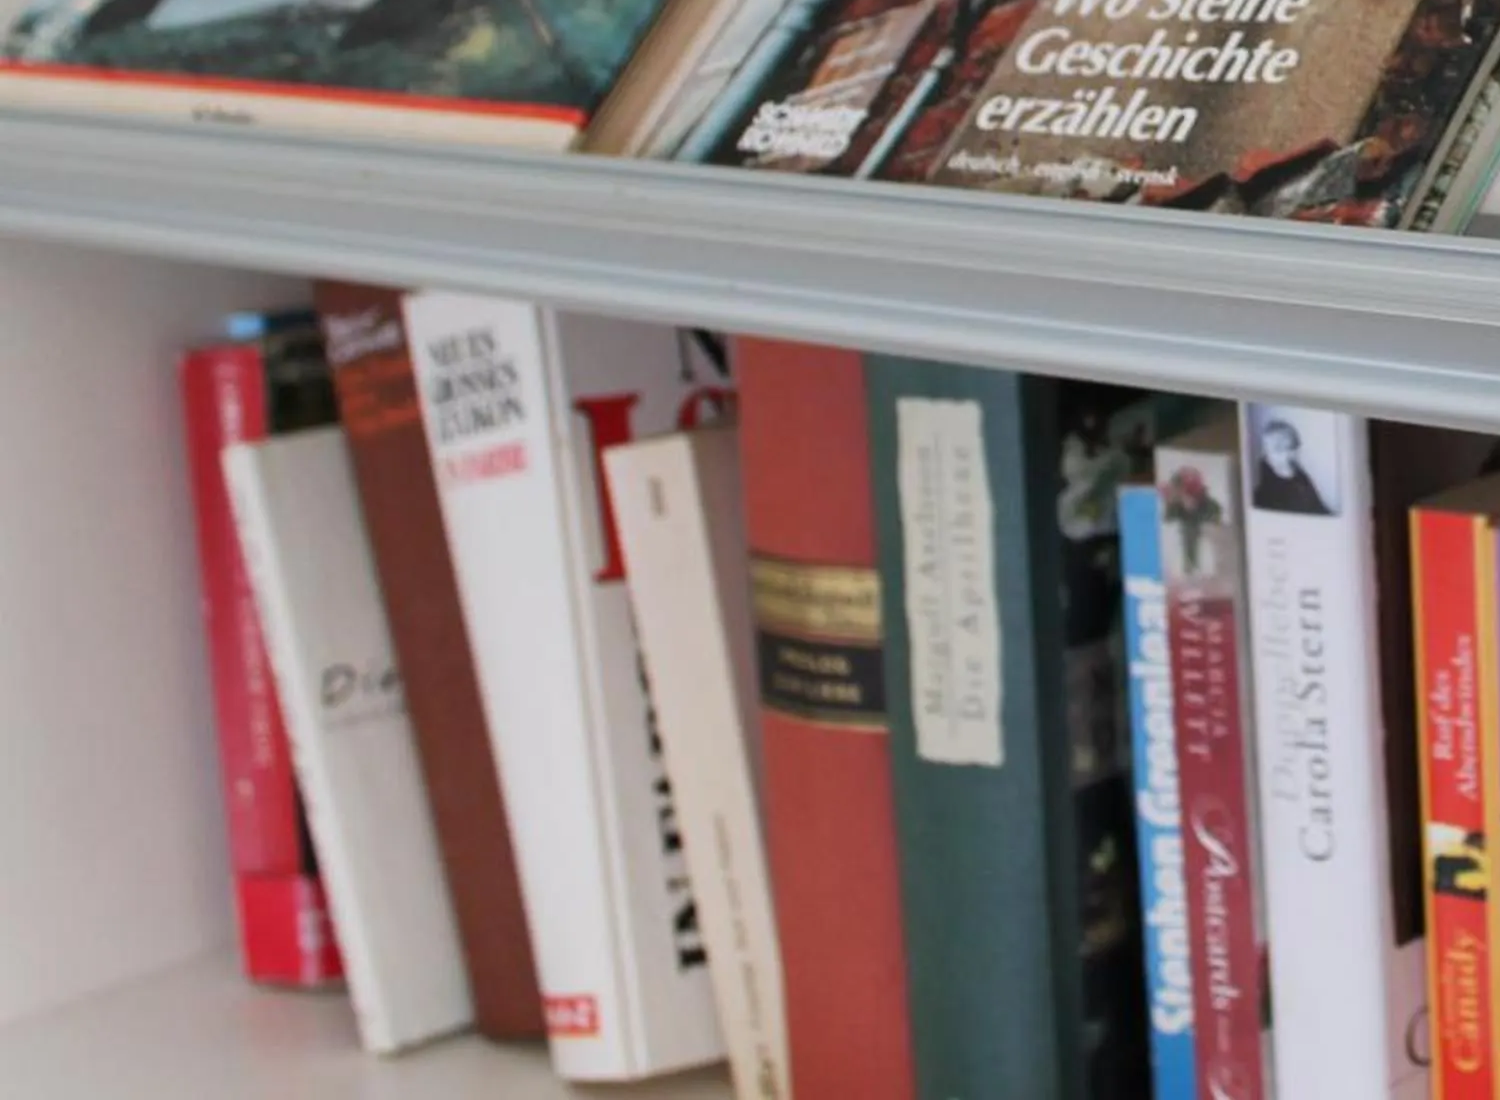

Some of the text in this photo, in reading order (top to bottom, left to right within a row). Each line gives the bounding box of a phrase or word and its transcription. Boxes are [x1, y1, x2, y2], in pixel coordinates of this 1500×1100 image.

[1014, 28, 1299, 84] Geschichte
[975, 87, 1199, 144] erzählen
[1296, 586, 1336, 864] Carola Stern
